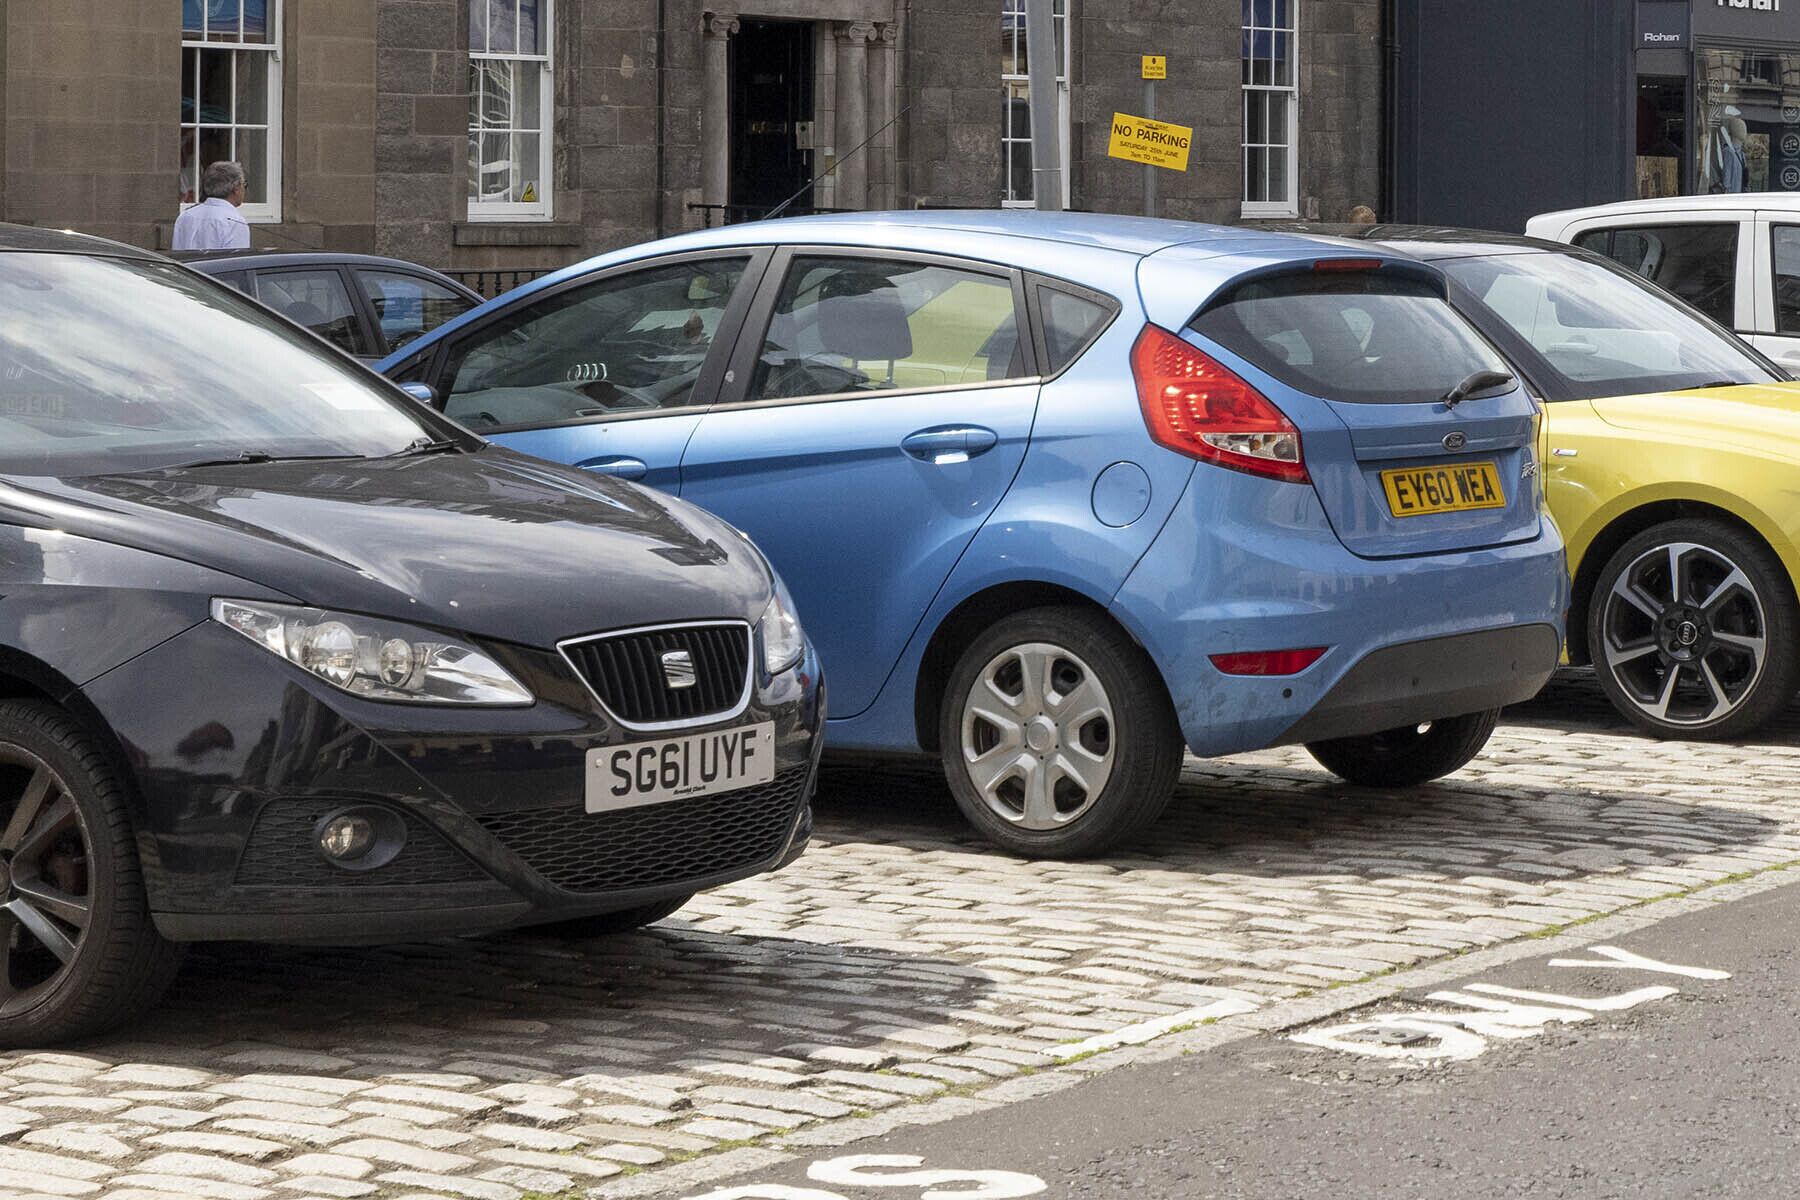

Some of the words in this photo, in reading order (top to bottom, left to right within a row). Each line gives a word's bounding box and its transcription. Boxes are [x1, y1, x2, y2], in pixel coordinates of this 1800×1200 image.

[1644, 32, 1680, 42] Rohan
[1114, 124, 1132, 137] NO
[1136, 129, 1189, 148] PARKING
[1119, 141, 1148, 152] SATURDAY
[1164, 150, 1179, 159] JUNE
[1393, 472, 1453, 510] EY60
[1454, 467, 1497, 504] WEA
[610, 741, 690, 796] SG61
[700, 730, 757, 783] UYF
[673, 787, 692, 795] Arnold
[1289, 945, 1733, 1066] ONLY
